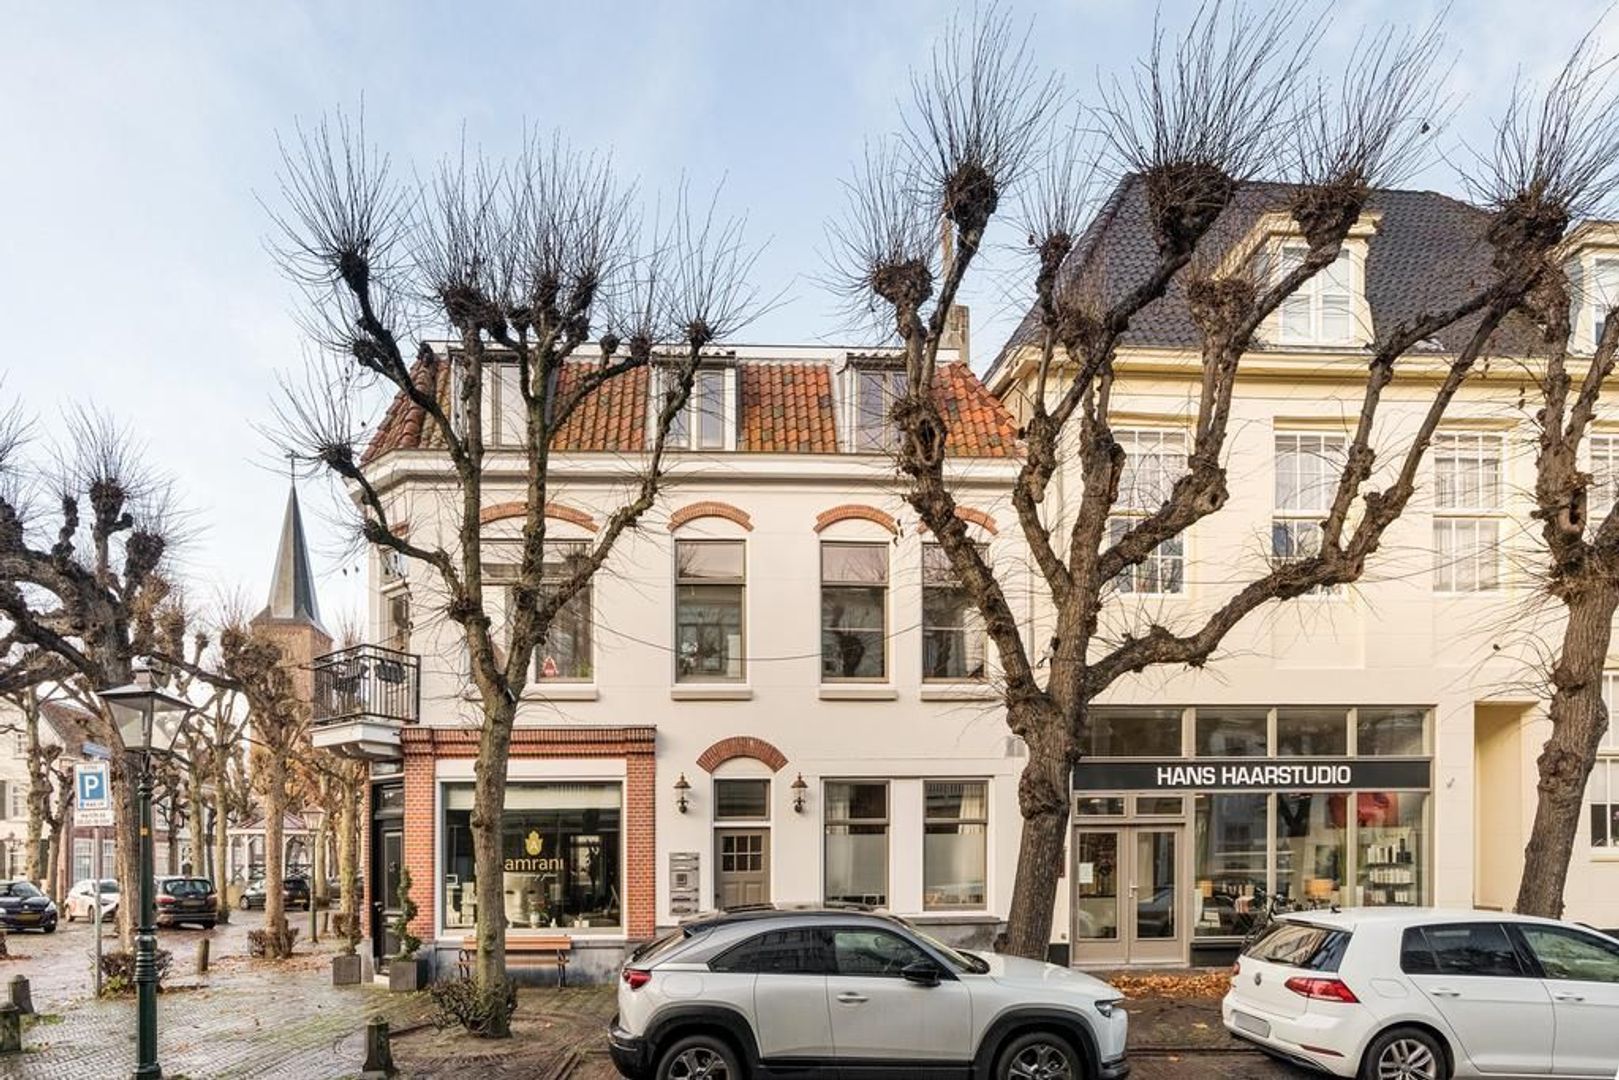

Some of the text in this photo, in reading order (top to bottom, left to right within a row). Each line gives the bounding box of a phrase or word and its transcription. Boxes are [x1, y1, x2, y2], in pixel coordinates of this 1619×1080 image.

[1157, 765, 1351, 785] HANS HAARSTUDIO
[84, 774, 100, 798] P
[504, 858, 564, 871] amrani
